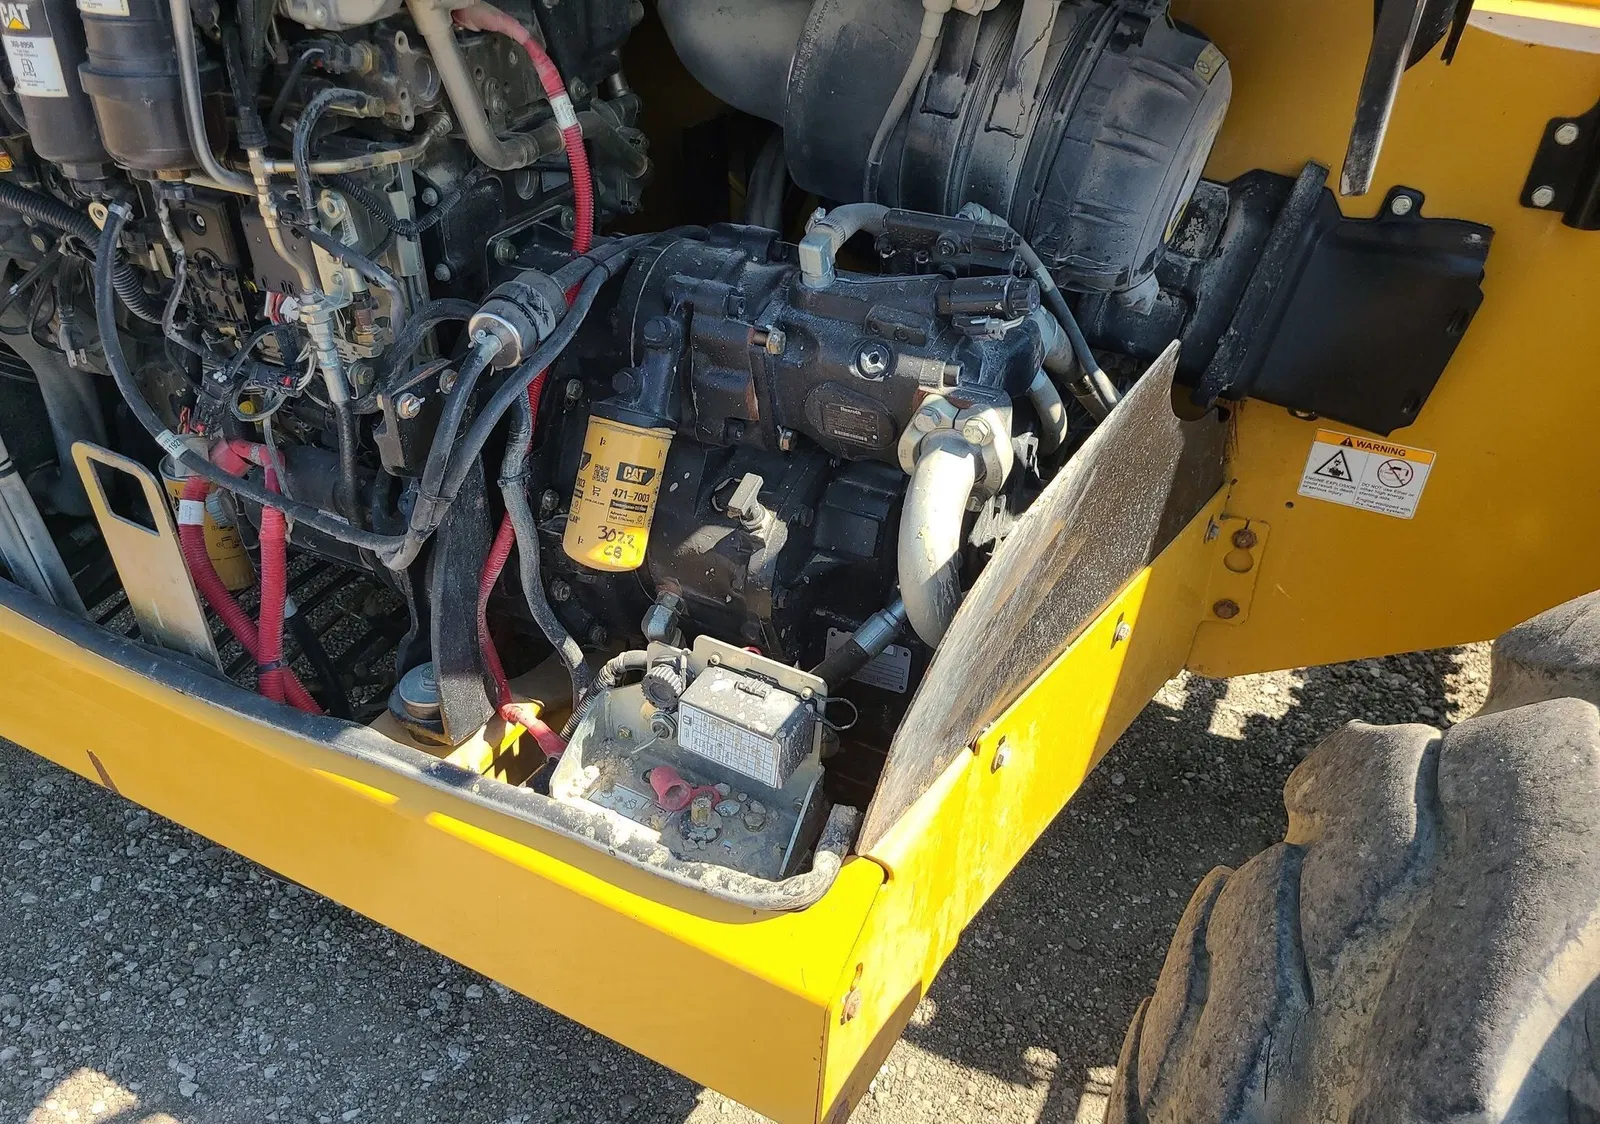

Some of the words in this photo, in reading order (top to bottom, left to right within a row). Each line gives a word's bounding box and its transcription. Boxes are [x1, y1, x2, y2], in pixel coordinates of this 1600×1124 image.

[0, 2, 30, 30] CAT
[1356, 440, 1406, 457] WARNING
[623, 465, 648, 482] CAT
[1305, 475, 1325, 483] ENGINE
[1326, 480, 1356, 490] EXPLOSION
[612, 488, 650, 503] 471-7003
